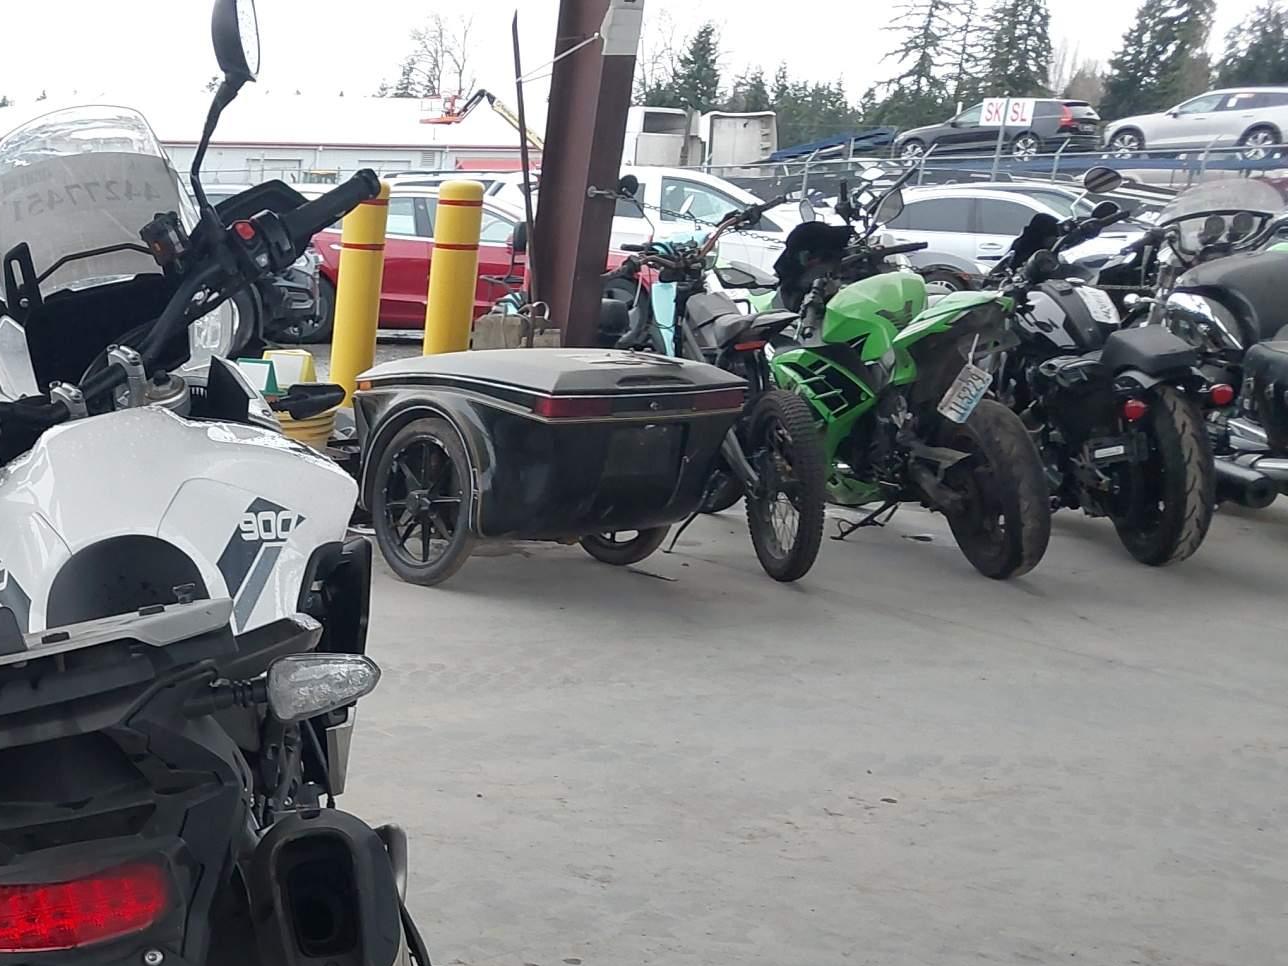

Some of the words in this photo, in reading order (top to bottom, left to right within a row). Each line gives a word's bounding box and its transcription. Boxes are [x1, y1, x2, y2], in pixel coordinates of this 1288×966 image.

[985, 102, 1005, 122] SK
[1010, 102, 1028, 122] SL
[239, 511, 295, 541] 900
